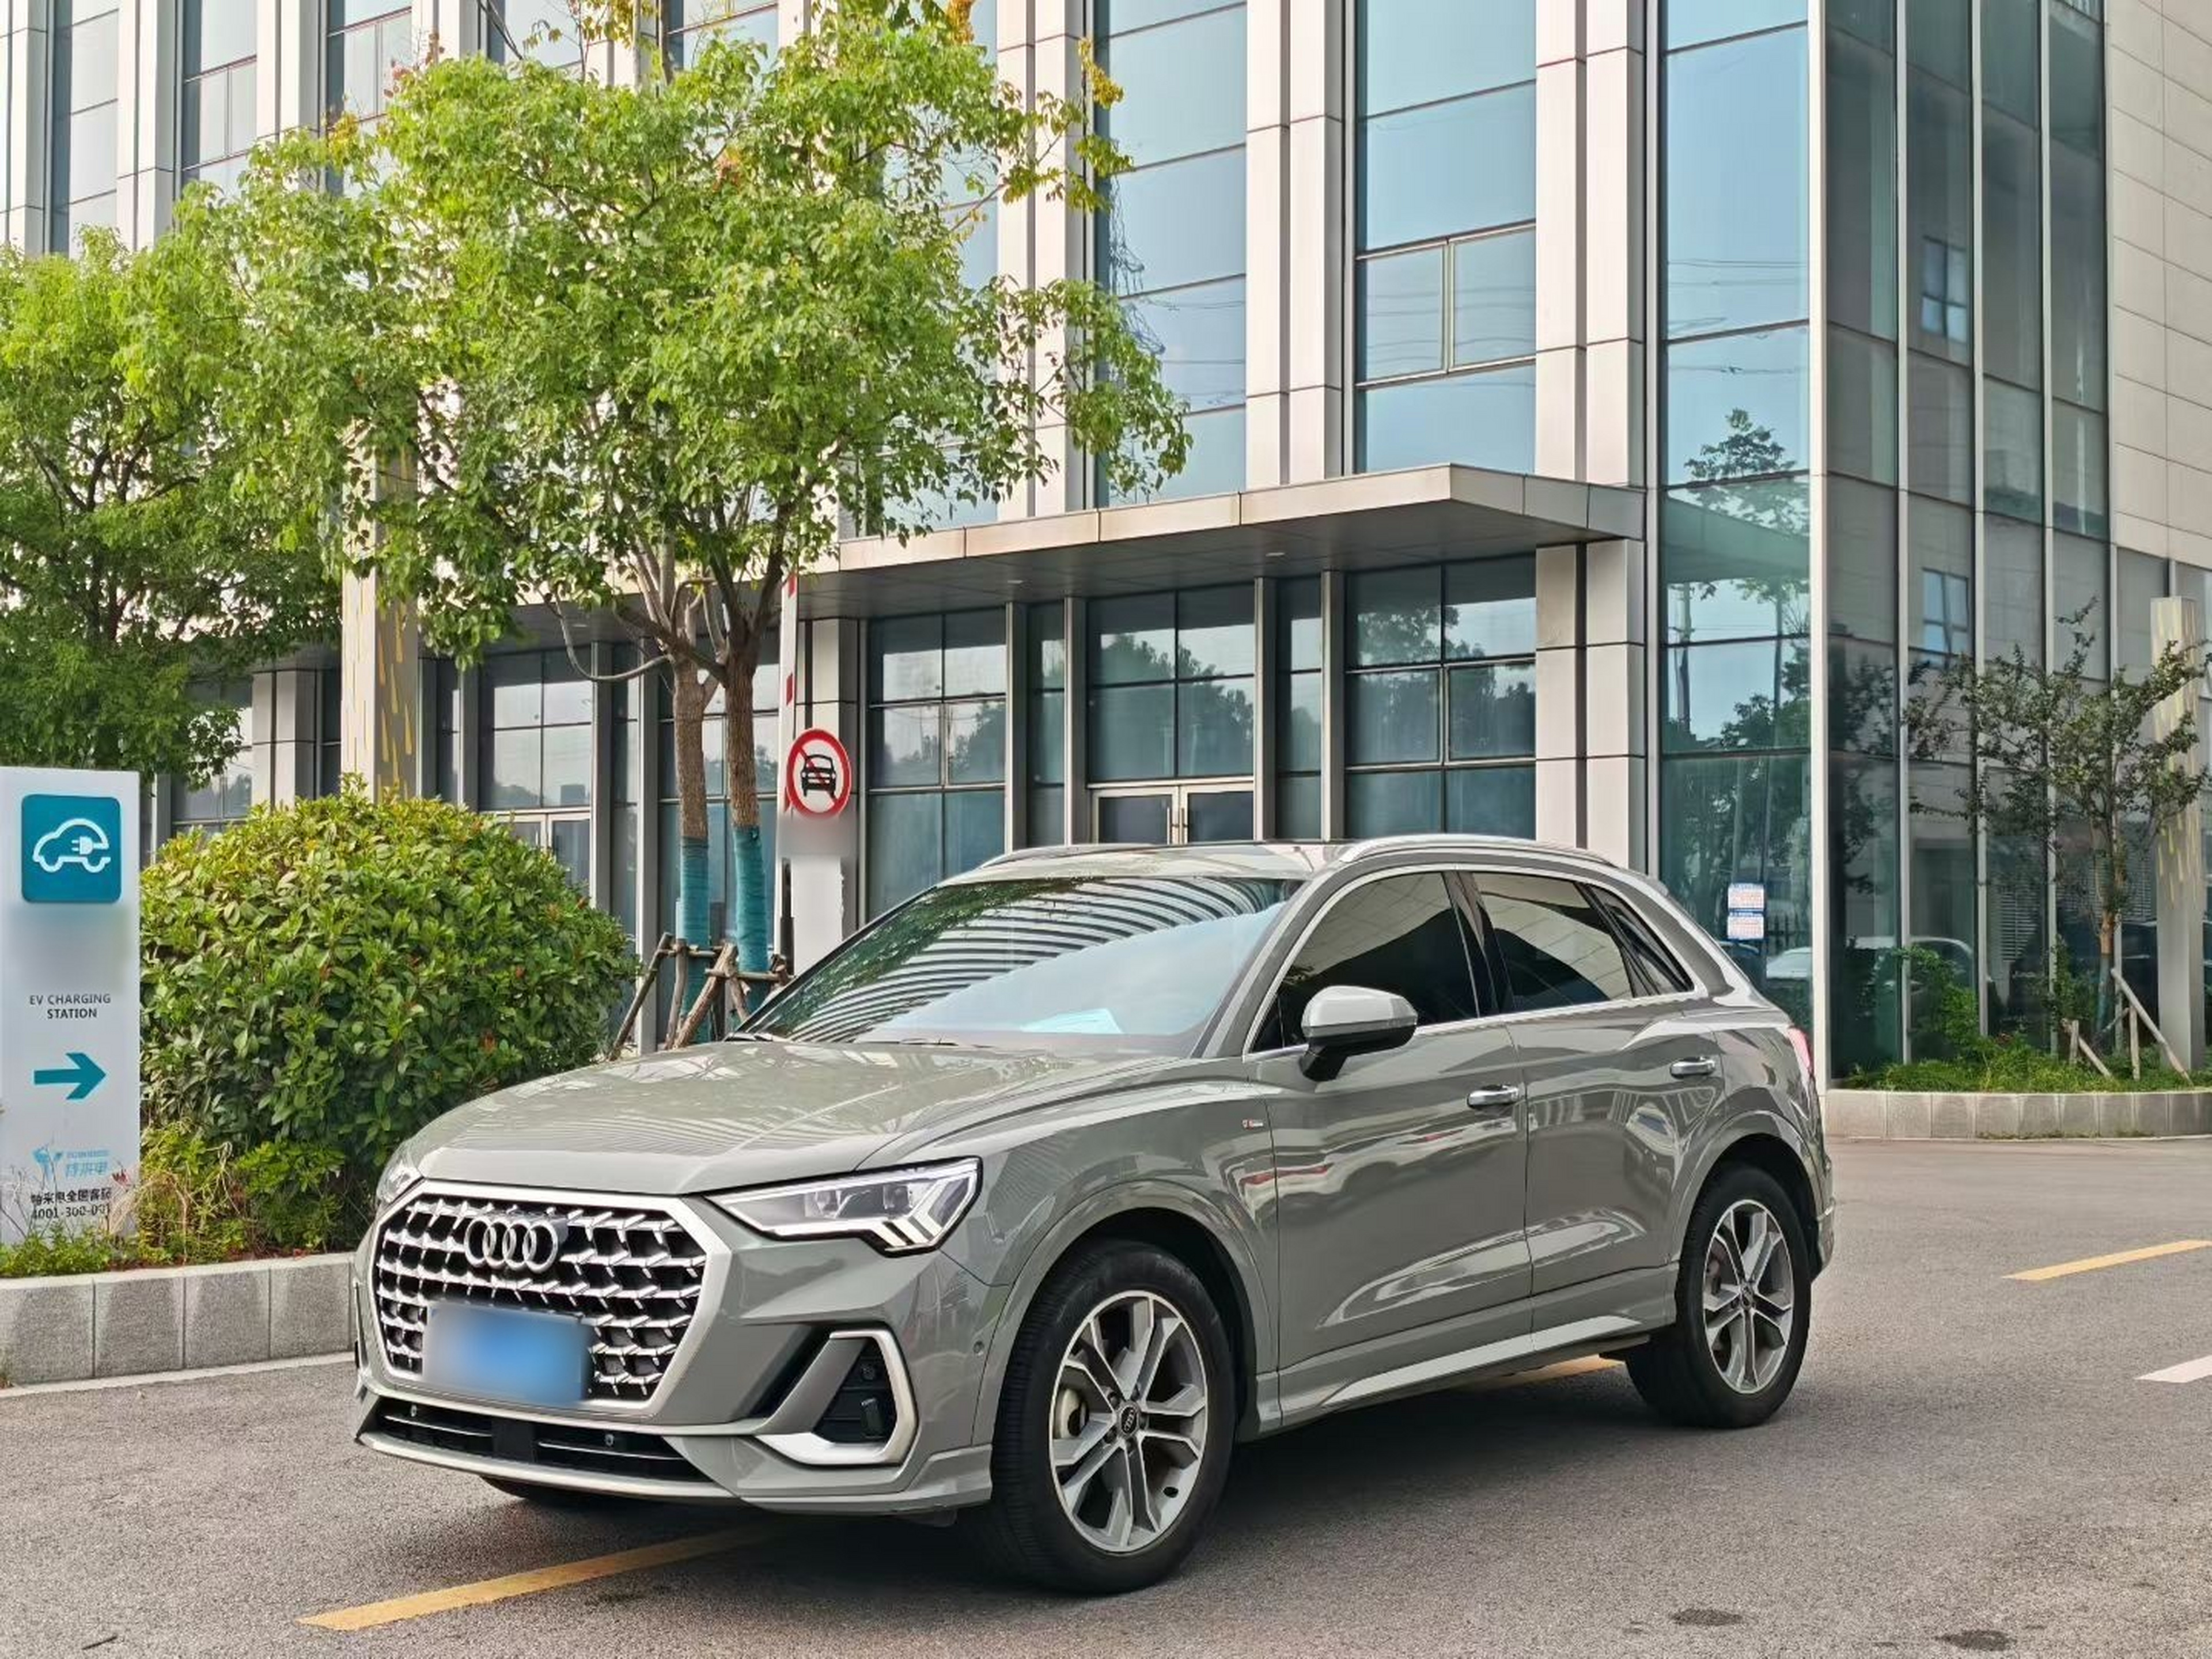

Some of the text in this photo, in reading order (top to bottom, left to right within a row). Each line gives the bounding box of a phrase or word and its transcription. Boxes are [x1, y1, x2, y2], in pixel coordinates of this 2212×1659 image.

[29, 993, 111, 1005] EV CHARGING
[47, 1008, 97, 1019] STATION
